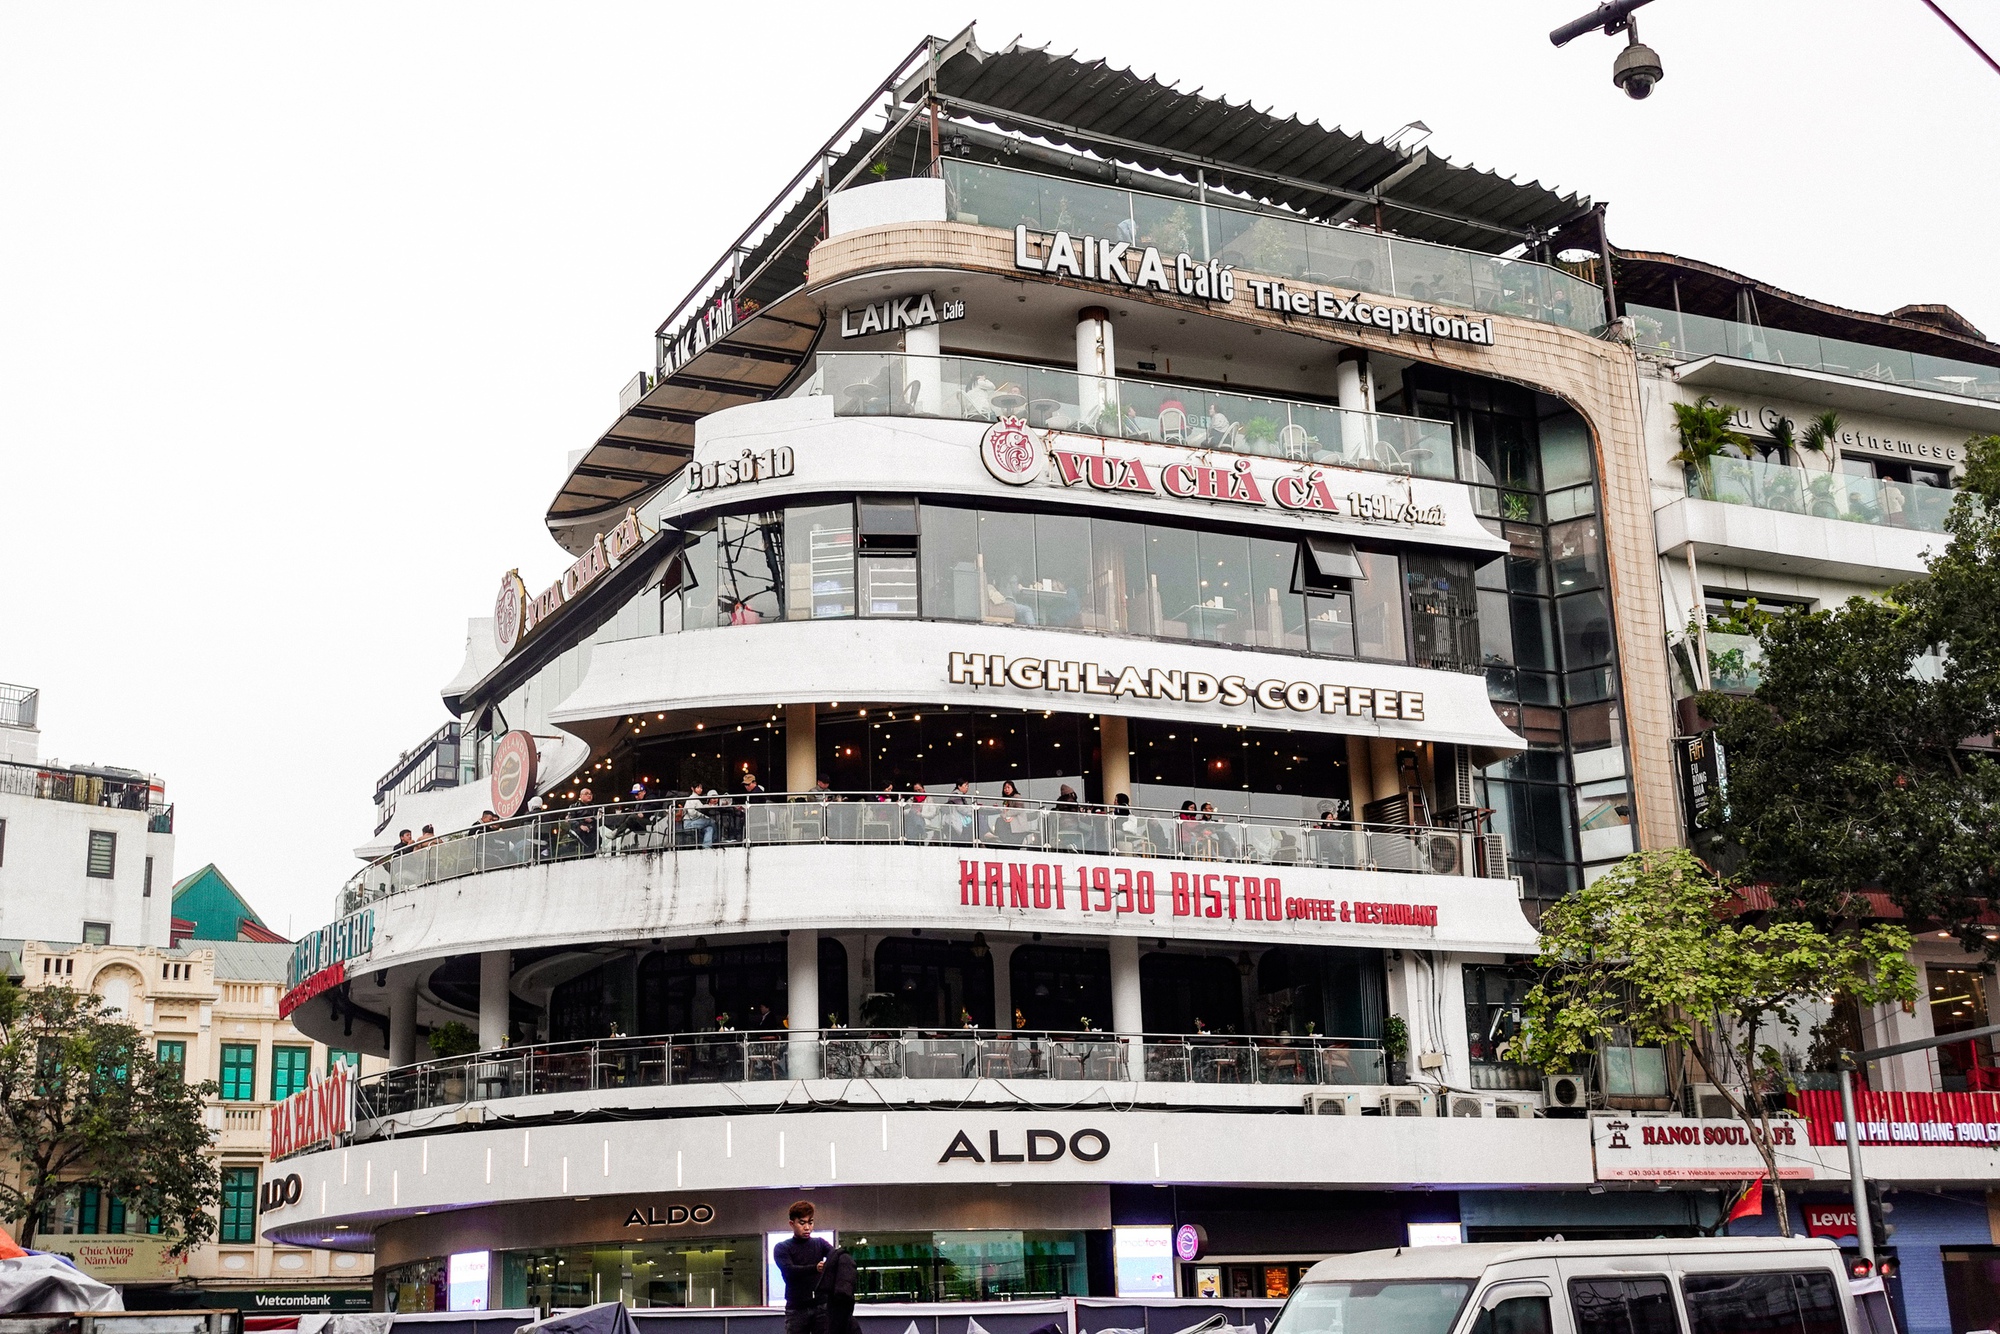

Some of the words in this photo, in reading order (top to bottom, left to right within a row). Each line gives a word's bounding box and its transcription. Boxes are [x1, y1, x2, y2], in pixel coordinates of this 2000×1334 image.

[1014, 224, 1169, 292] LAIKA
[1175, 253, 1234, 303] Café
[1249, 279, 1311, 315] The
[1316, 291, 1495, 347] Exceptional
[841, 294, 938, 338] LAIKA
[943, 300, 965, 321] Café
[1832, 430, 1958, 461] ietnamese
[1049, 449, 1157, 495] VUA
[1162, 459, 1267, 507] CHẢ
[1272, 470, 1340, 515] CÁ
[948, 651, 1248, 707] HIGHLANDS
[1256, 679, 1426, 722] COFFEE
[958, 859, 1066, 910] HANOI
[1077, 864, 1157, 915] 1930
[1170, 871, 1282, 922] BISTRO
[1285, 895, 1336, 923] COFFEE
[1339, 902, 1351, 923] &
[1354, 901, 1439, 927] RESTAURANT
[323, 909, 374, 968] BISTRO
[270, 1100, 293, 1162] BIA
[937, 1127, 1111, 1165] ALDO
[1641, 1126, 1700, 1145] HANOI
[1703, 1126, 1749, 1145] SOUL
[1833, 1121, 1867, 1141] MN
[1890, 1121, 1920, 1141] GIAO
[259, 1173, 302, 1214] LDO
[623, 1203, 715, 1228] ALDO
[256, 1294, 331, 1306] Vietcombank
